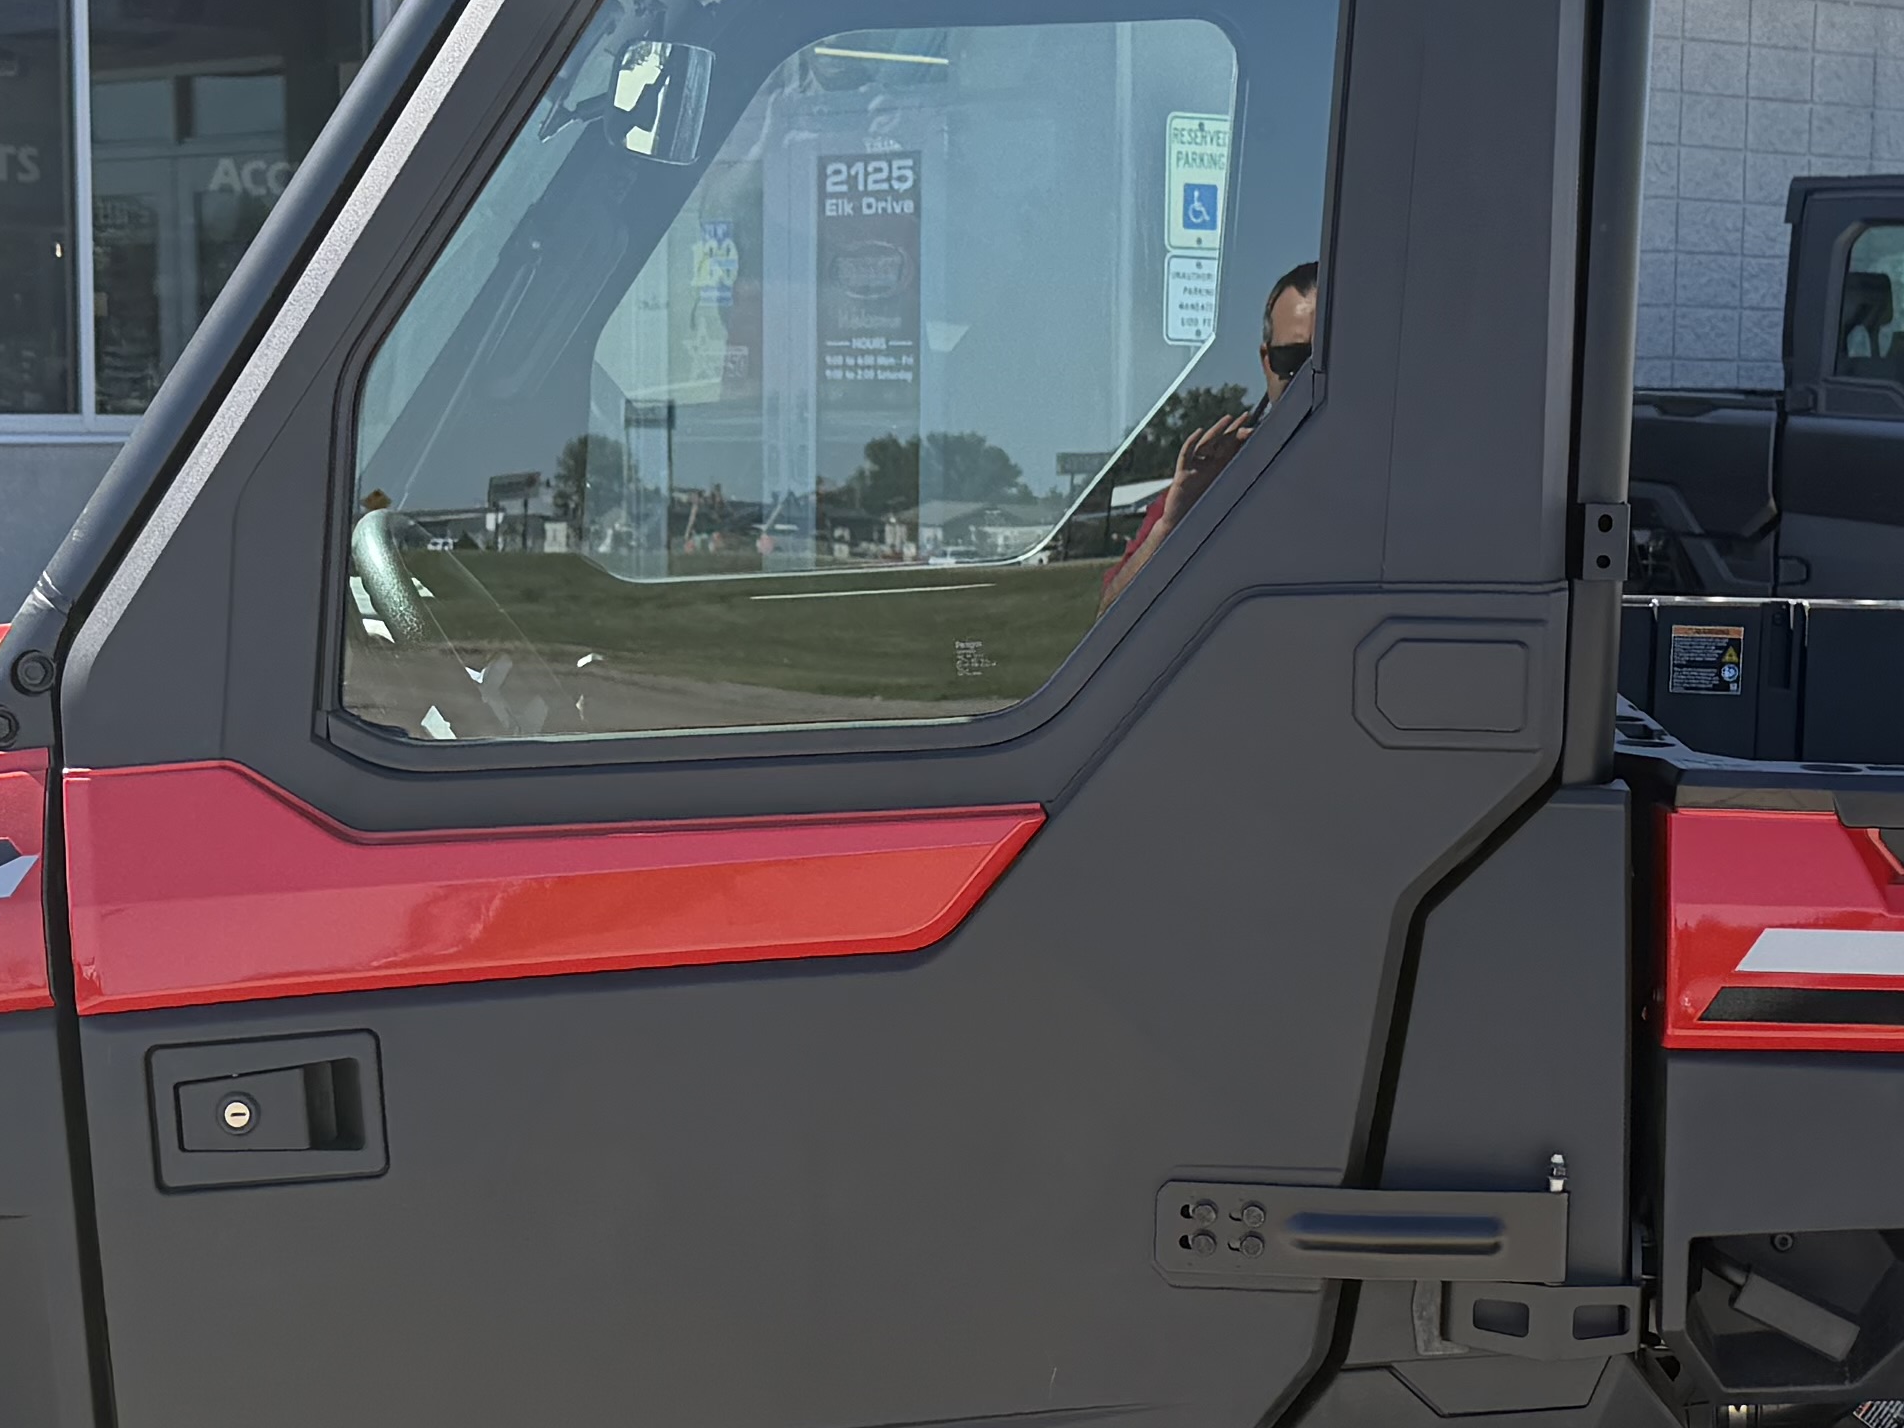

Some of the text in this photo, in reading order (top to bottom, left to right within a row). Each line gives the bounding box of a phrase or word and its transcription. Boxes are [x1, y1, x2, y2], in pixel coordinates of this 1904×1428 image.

[1176, 150, 1225, 171] PARKING
[826, 158, 914, 193] 2125
[825, 195, 914, 217] Elk Drive
